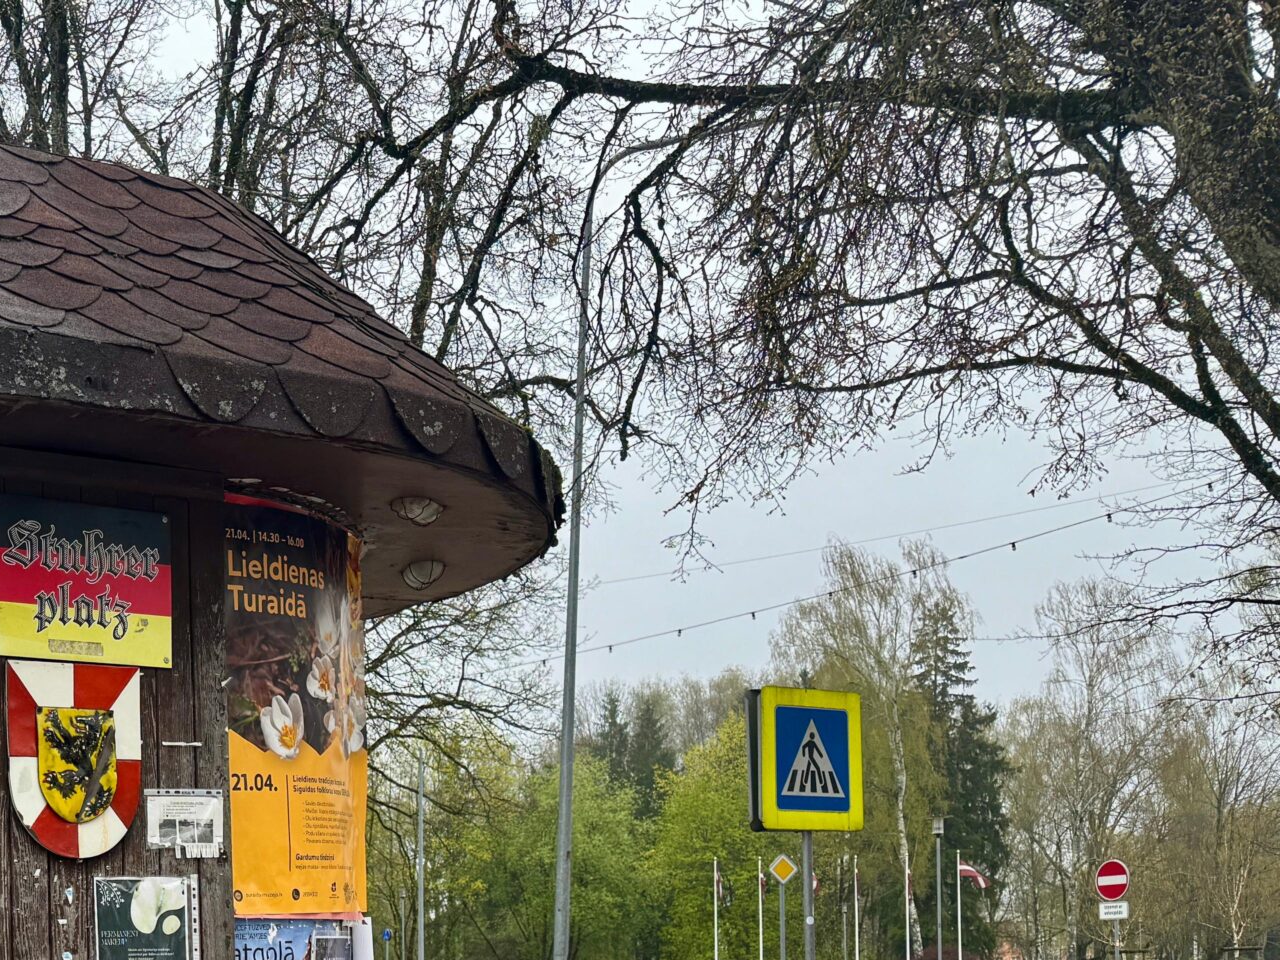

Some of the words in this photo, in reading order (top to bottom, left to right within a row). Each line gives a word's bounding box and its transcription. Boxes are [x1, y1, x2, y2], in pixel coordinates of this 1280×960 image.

[2, 520, 160, 584] Stuhrer
[226, 528, 250, 540] 21.04.
[258, 532, 280, 542] 14.30
[287, 536, 304, 548] 16.00
[228, 550, 324, 590] Lieldienas
[34, 581, 132, 640] platz
[228, 584, 306, 618] Turaidā
[231, 774, 278, 792] 21.04.
